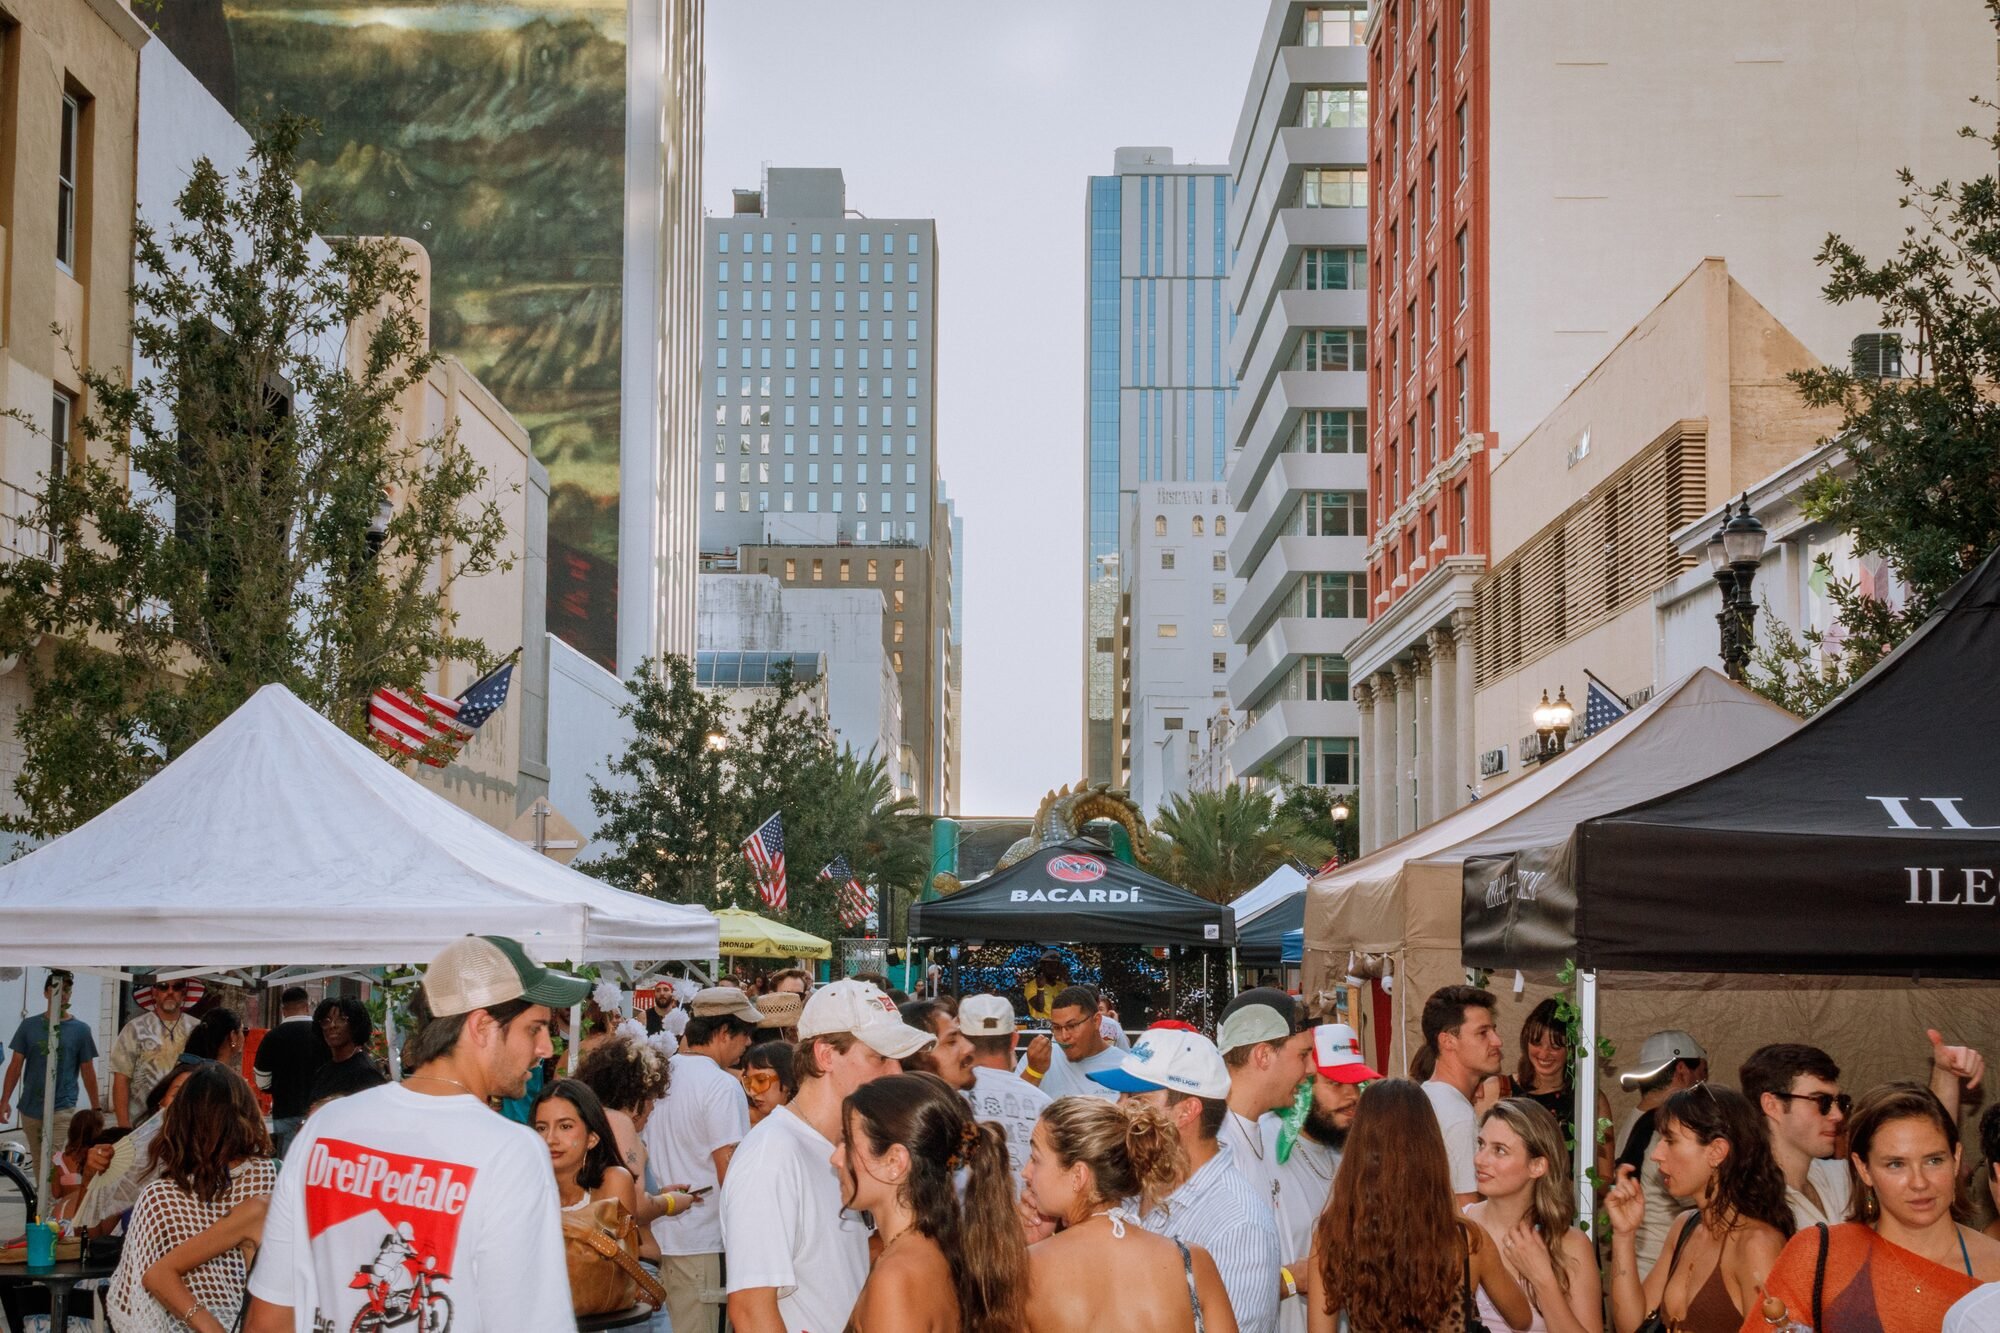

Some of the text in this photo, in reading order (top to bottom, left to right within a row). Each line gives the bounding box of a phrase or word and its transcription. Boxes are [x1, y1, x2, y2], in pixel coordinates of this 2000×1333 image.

[1904, 867, 2000, 906] ILE
[1010, 886, 1141, 903] BACARDÍ
[719, 941, 754, 949] EMONADE
[778, 944, 824, 954] FROZEN LEMONADE
[1182, 1079, 1199, 1087] LIGHT
[307, 1143, 467, 1215] DreiPedale
